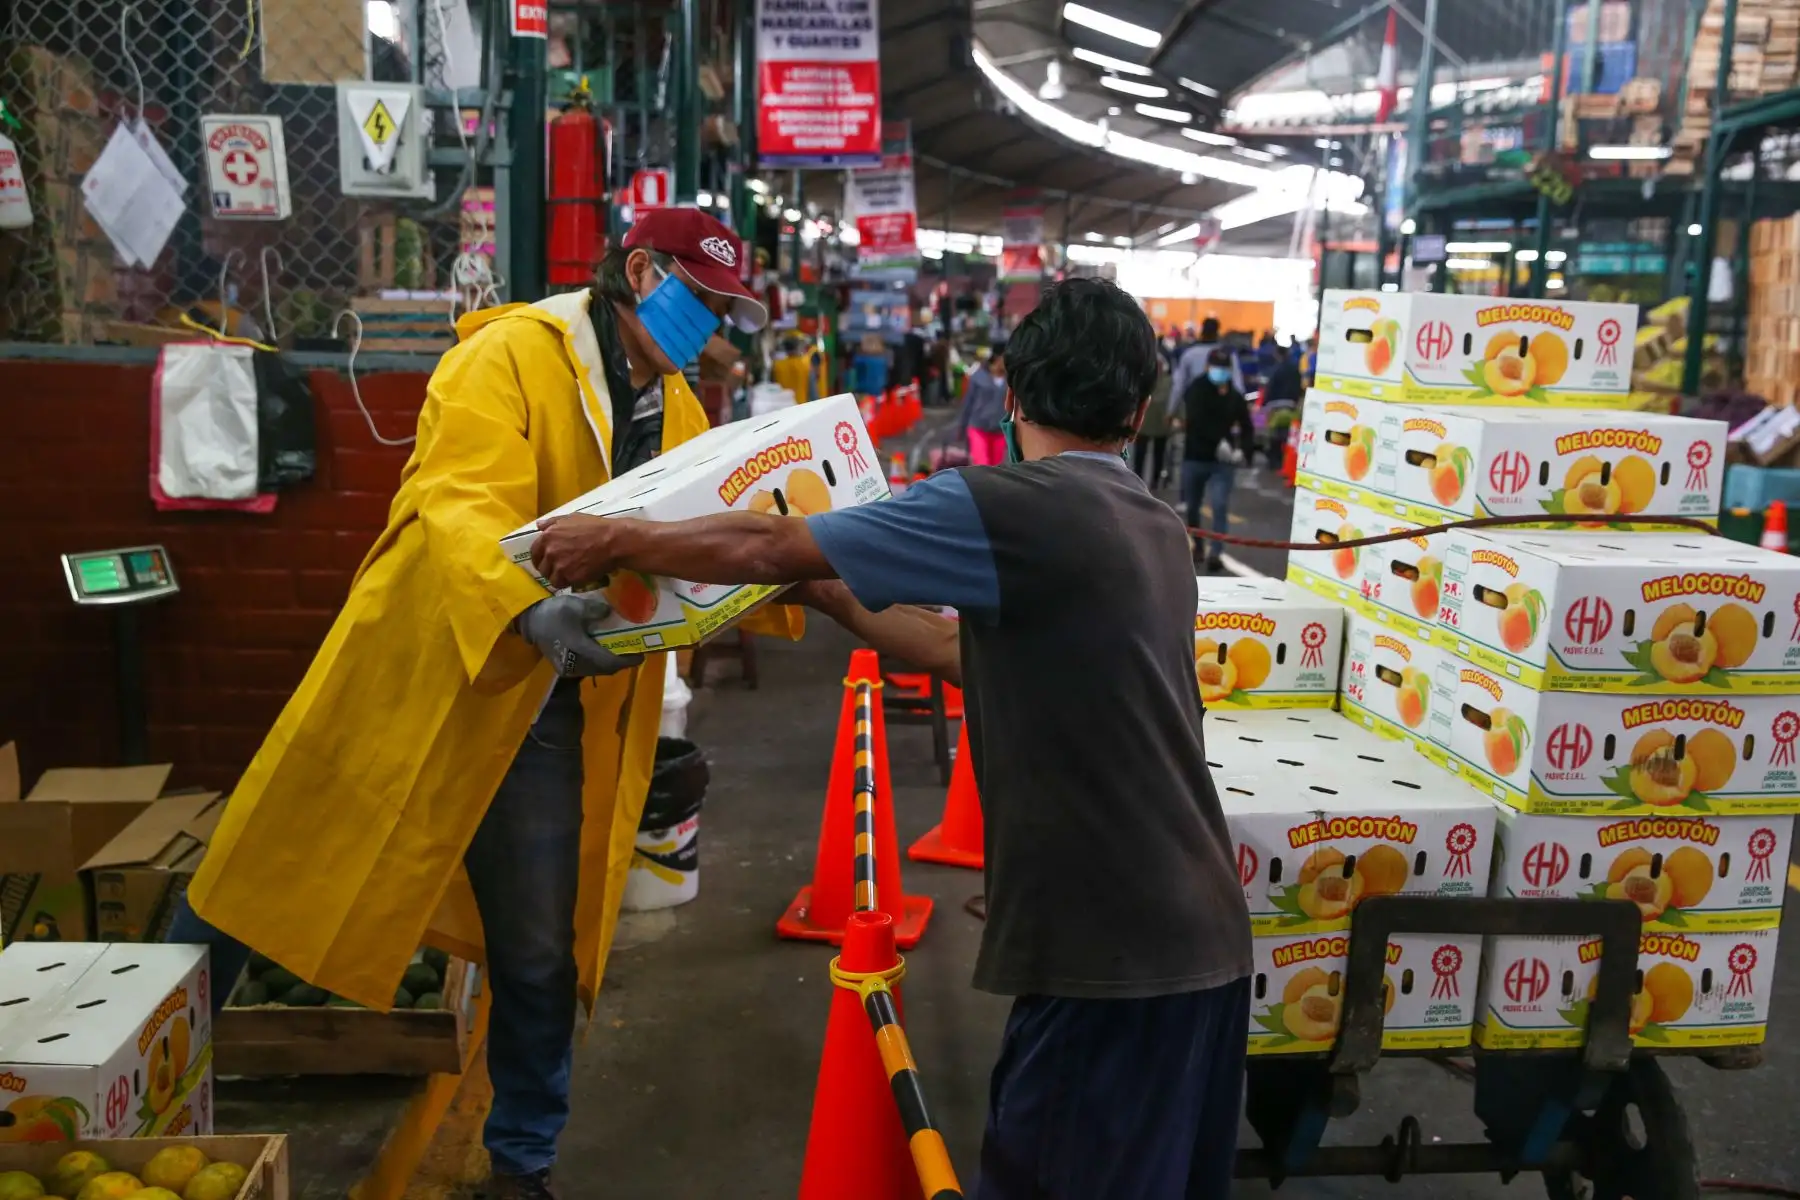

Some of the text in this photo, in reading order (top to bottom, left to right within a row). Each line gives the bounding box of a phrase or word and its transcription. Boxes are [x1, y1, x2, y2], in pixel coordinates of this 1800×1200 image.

[1476, 304, 1575, 331] MELOCOTÓN
[1556, 428, 1662, 456] MELOCOTÓN
[718, 435, 813, 507] MELOCOTÓN
[513, 551, 532, 560] PUEST
[1472, 549, 1519, 578] MELOCOTÓN
[1641, 572, 1766, 604] MELOCOTÓN
[1194, 612, 1276, 637] LOCOTÓN
[1459, 669, 1504, 702] MELOCOTÓN
[1621, 699, 1745, 730] MELOCOTÓN
[1288, 815, 1418, 849] MELOCOTÓN
[1597, 817, 1720, 848] MELOCOTÓN
[1272, 937, 1402, 968] MELOCN
[138, 986, 188, 1057] MELOCOTÓN
